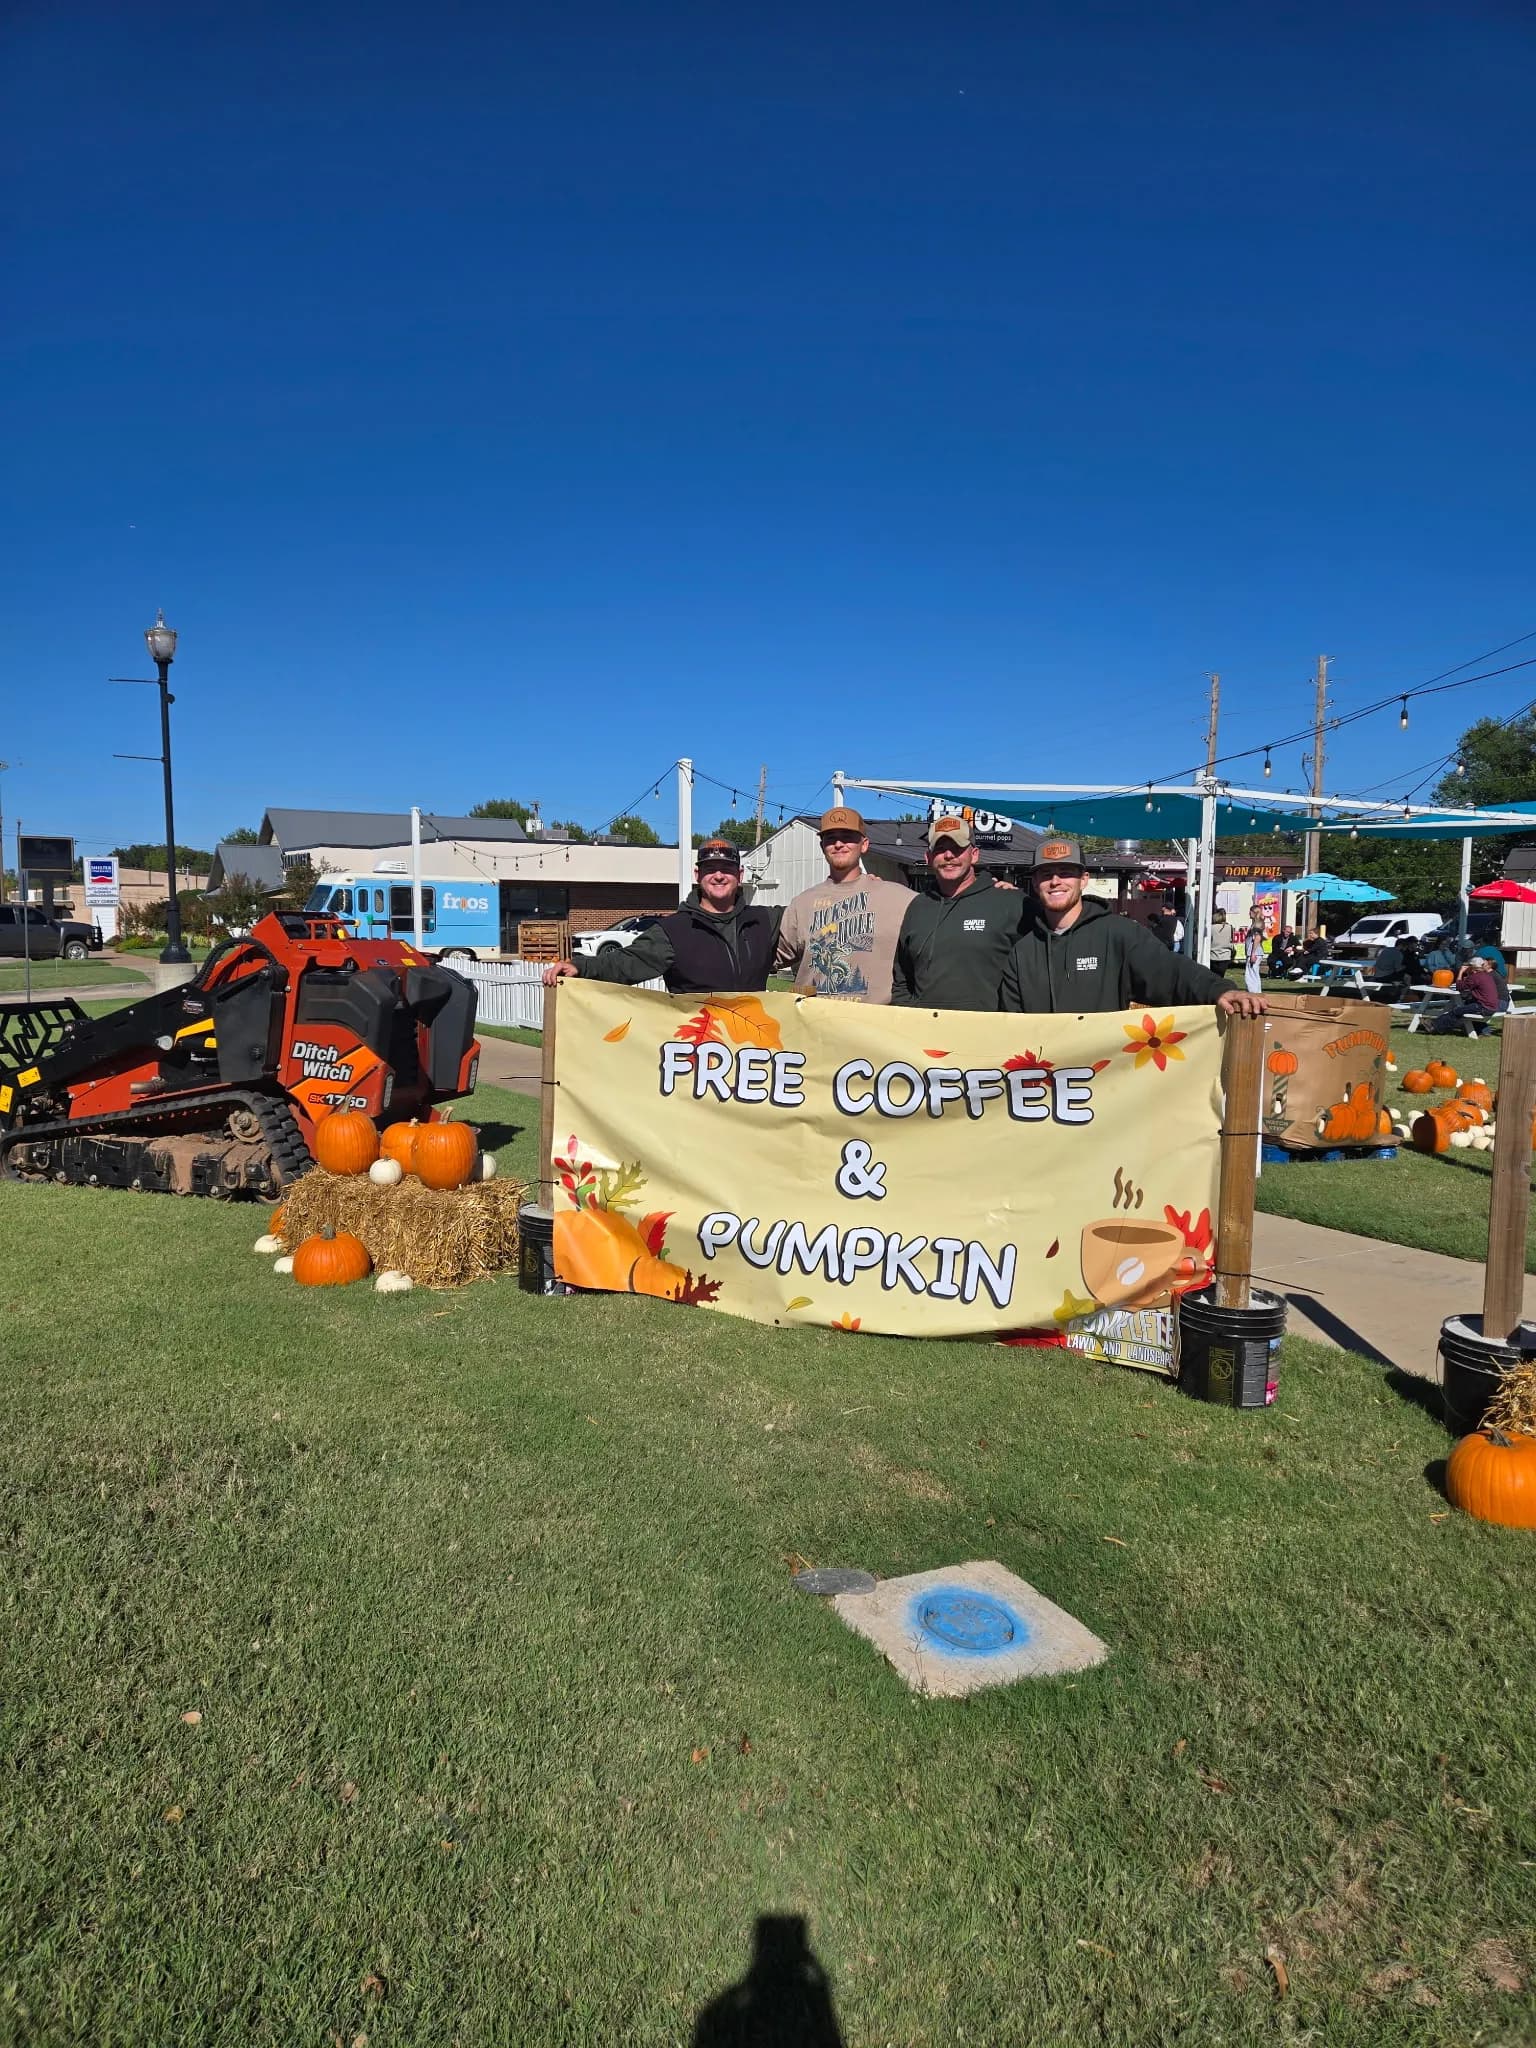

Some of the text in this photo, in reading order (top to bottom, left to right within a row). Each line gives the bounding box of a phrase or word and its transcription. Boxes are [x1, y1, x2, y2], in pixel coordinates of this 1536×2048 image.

[1225, 866, 1282, 877] DON PIBIL
[809, 891, 869, 933] JACKSON
[292, 1041, 338, 1061] Ditch
[303, 1061, 353, 1081] Witch
[660, 1041, 1096, 1125] FREE COFFEE
[836, 1139, 887, 1200] &
[699, 1211, 1018, 1308] PUMPKIN
[1066, 1334, 1096, 1352] LAWN
[1103, 1341, 1121, 1356] AND
